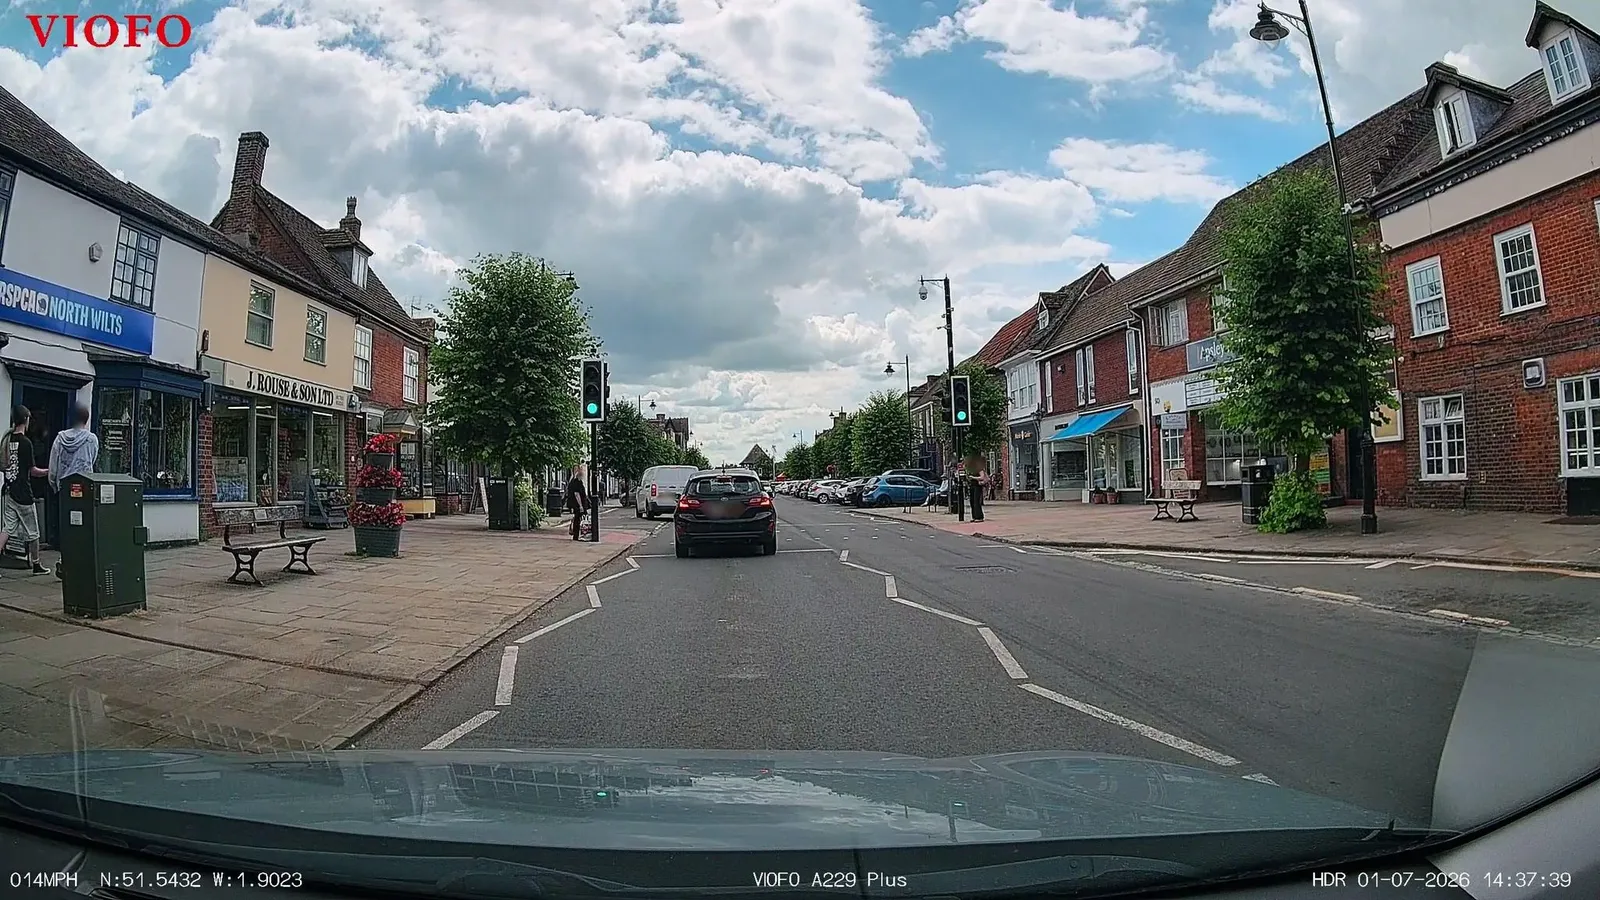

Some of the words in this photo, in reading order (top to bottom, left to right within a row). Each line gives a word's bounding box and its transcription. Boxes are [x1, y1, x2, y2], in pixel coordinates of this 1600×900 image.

[0, 281, 36, 313] RSPCA
[49, 296, 89, 326] NORTH
[91, 307, 123, 335] WILTS
[246, 371, 256, 389] J.
[257, 373, 290, 397] ROUSE
[291, 382, 299, 399] &
[299, 384, 318, 404] SON
[317, 388, 334, 406] LTD
